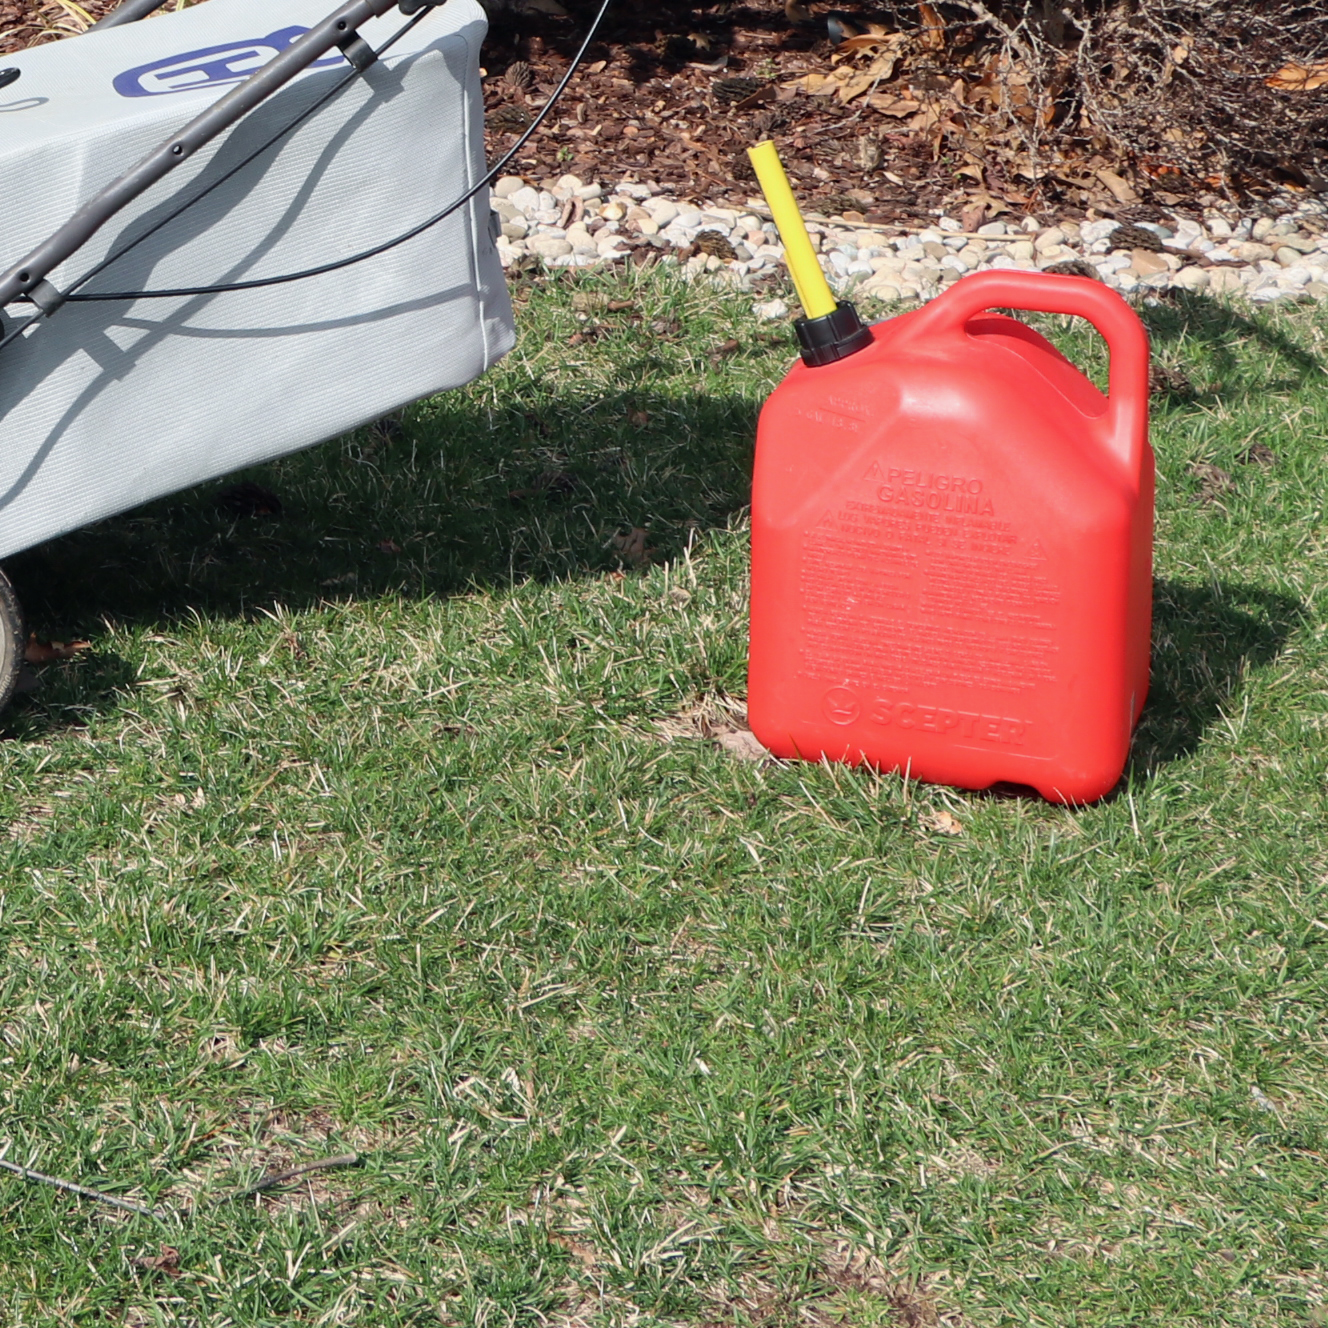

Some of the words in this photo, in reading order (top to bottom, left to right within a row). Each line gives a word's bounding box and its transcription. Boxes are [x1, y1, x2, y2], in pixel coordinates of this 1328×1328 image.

[887, 467, 984, 496] PELIGRO
[877, 484, 995, 517] GASOLINA
[871, 698, 1025, 746] SCEPTER
